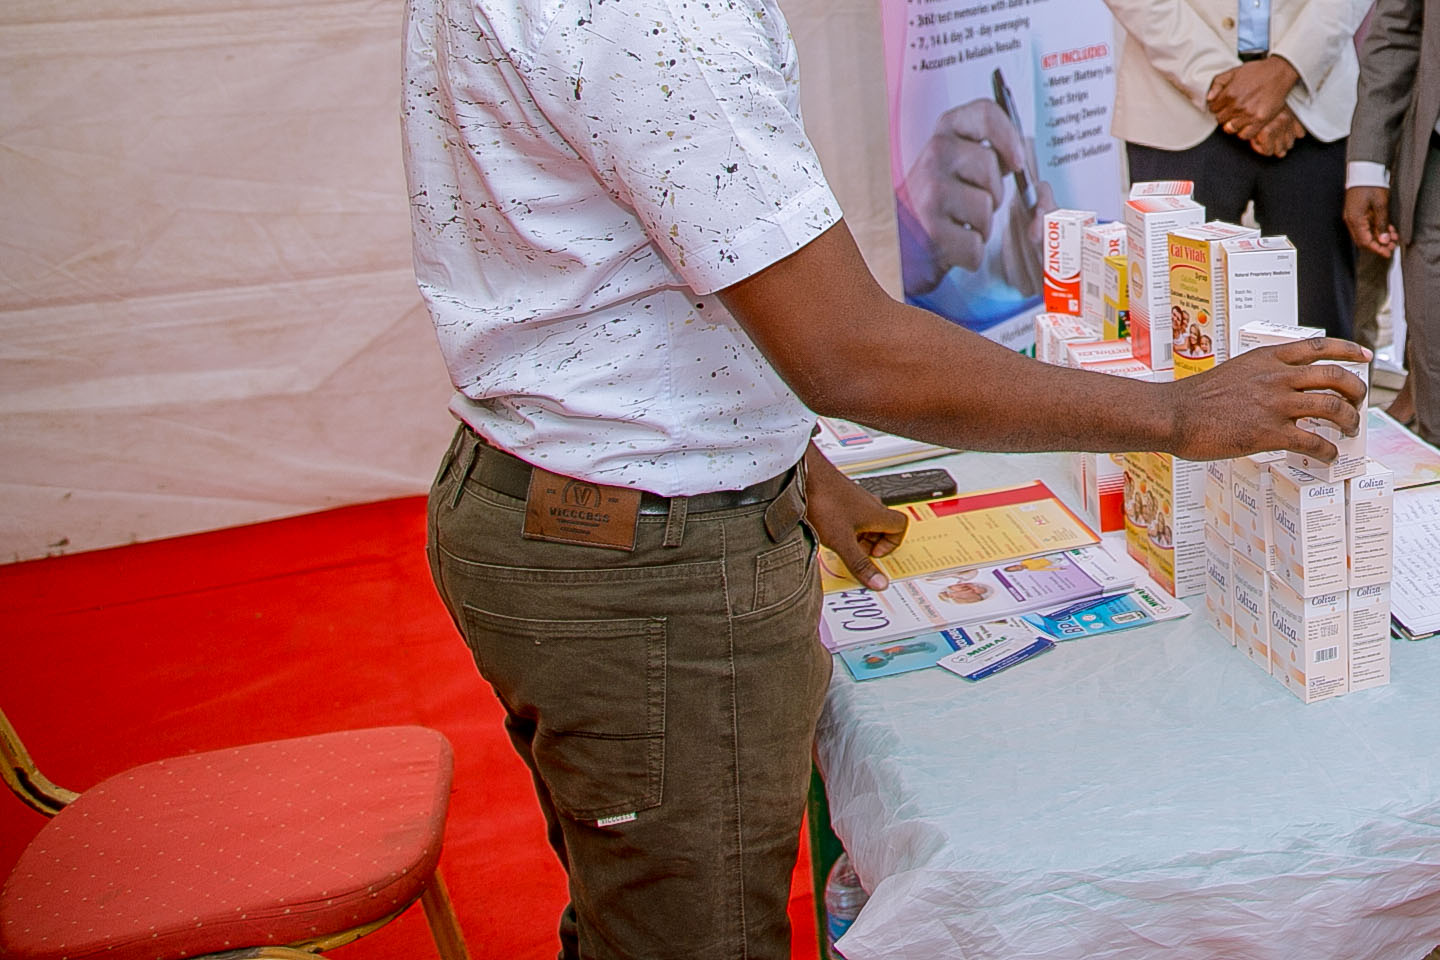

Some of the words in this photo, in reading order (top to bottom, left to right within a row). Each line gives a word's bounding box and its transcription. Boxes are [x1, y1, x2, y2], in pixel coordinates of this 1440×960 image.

[1047, 220, 1060, 274] ZINCOR
[1170, 243, 1183, 258] Cal
[1184, 246, 1207, 264] Vitals
[1234, 482, 1257, 510] Coliza
[1308, 486, 1335, 498] Coliza
[1358, 478, 1384, 489] Coliza
[1274, 504, 1296, 534] Coliza
[1206, 558, 1225, 586] Coliza
[1235, 585, 1258, 614] Coliza
[1311, 595, 1337, 606] Coliza
[1356, 585, 1381, 597] Coliza
[828, 587, 890, 632] Coliz
[1271, 611, 1297, 641] Coliza
